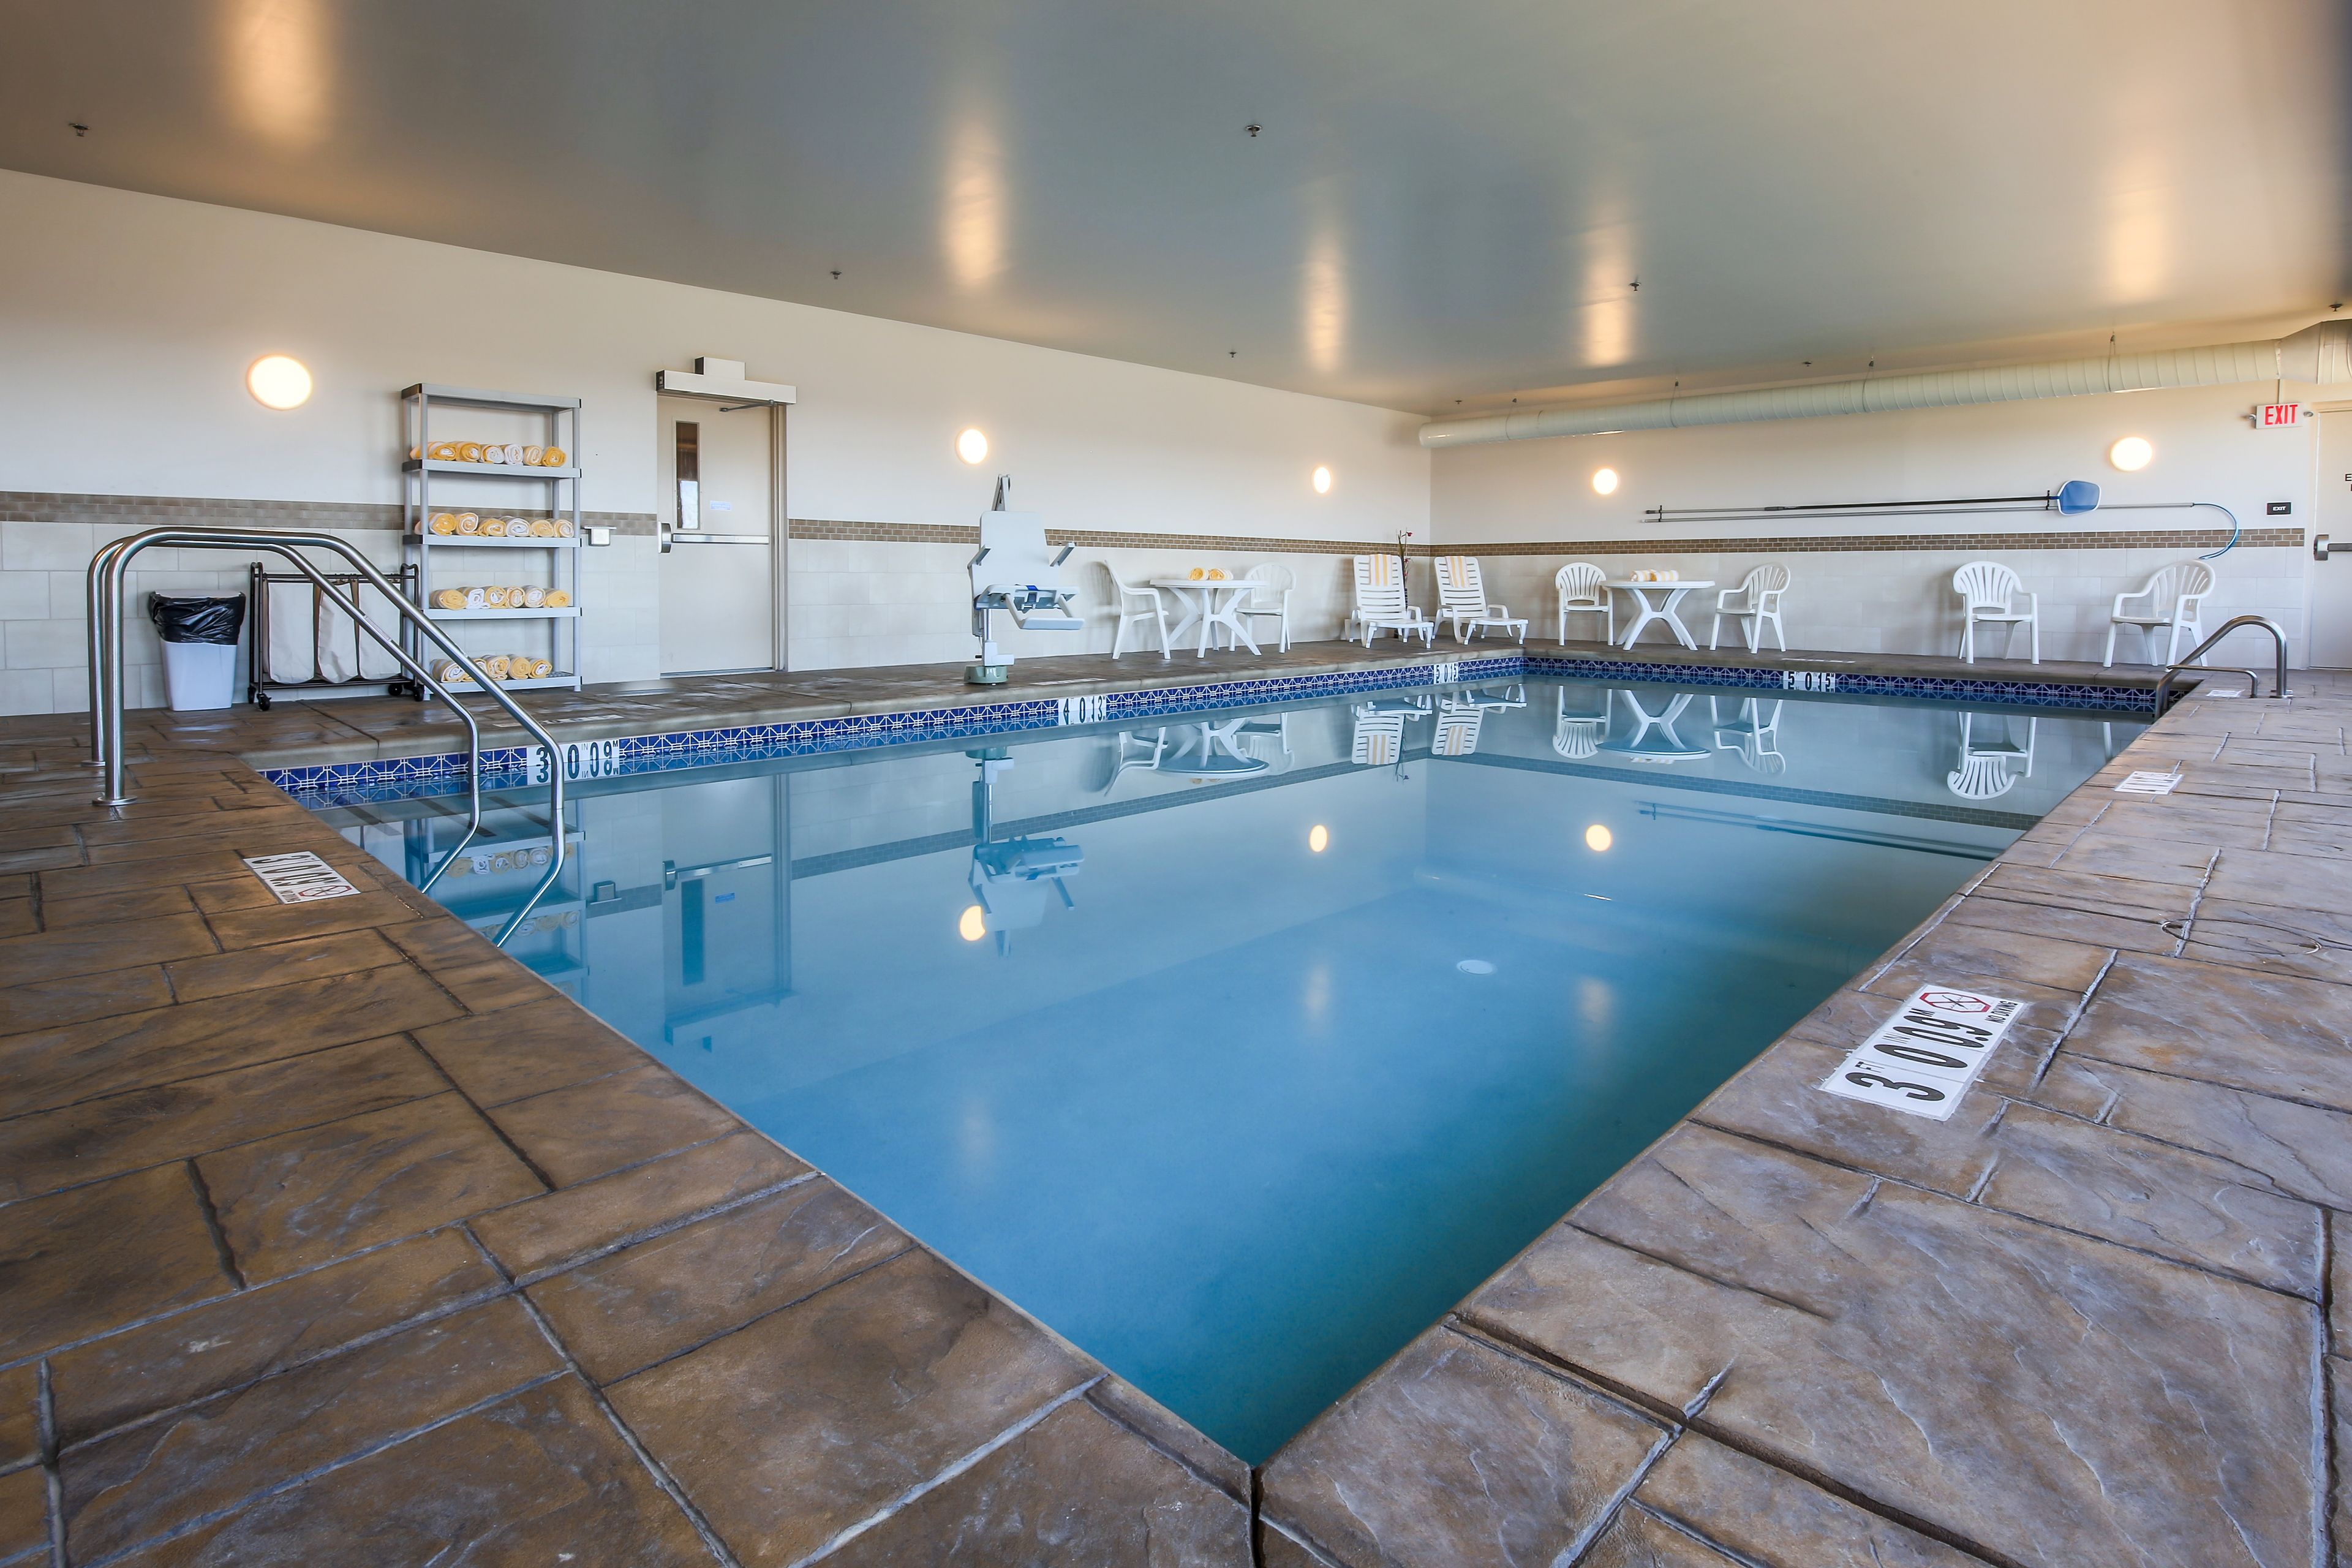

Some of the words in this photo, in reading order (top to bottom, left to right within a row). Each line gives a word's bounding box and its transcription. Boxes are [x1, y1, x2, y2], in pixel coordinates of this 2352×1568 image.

[2265, 404, 2298, 425] EXIT
[1436, 665, 1440, 676] 5
[1788, 671, 1795, 681] 5
[1805, 672, 1812, 683] 0
[1063, 698, 1070, 713] 4
[1079, 697, 1086, 713] 0
[536, 747, 549, 767] 3
[252, 854, 311, 864] 3
[262, 864, 322, 873] 0
[1909, 1008, 1936, 1017] M
[1992, 1001, 2018, 1017] DIVING
[1985, 1015, 2007, 1023] NO
[1893, 1016, 1993, 1048] 0.9
[1882, 1033, 1911, 1044] IN
[1874, 1044, 1968, 1068] 0
[1855, 1061, 1885, 1072] FT
[1845, 1072, 1945, 1101] 3
